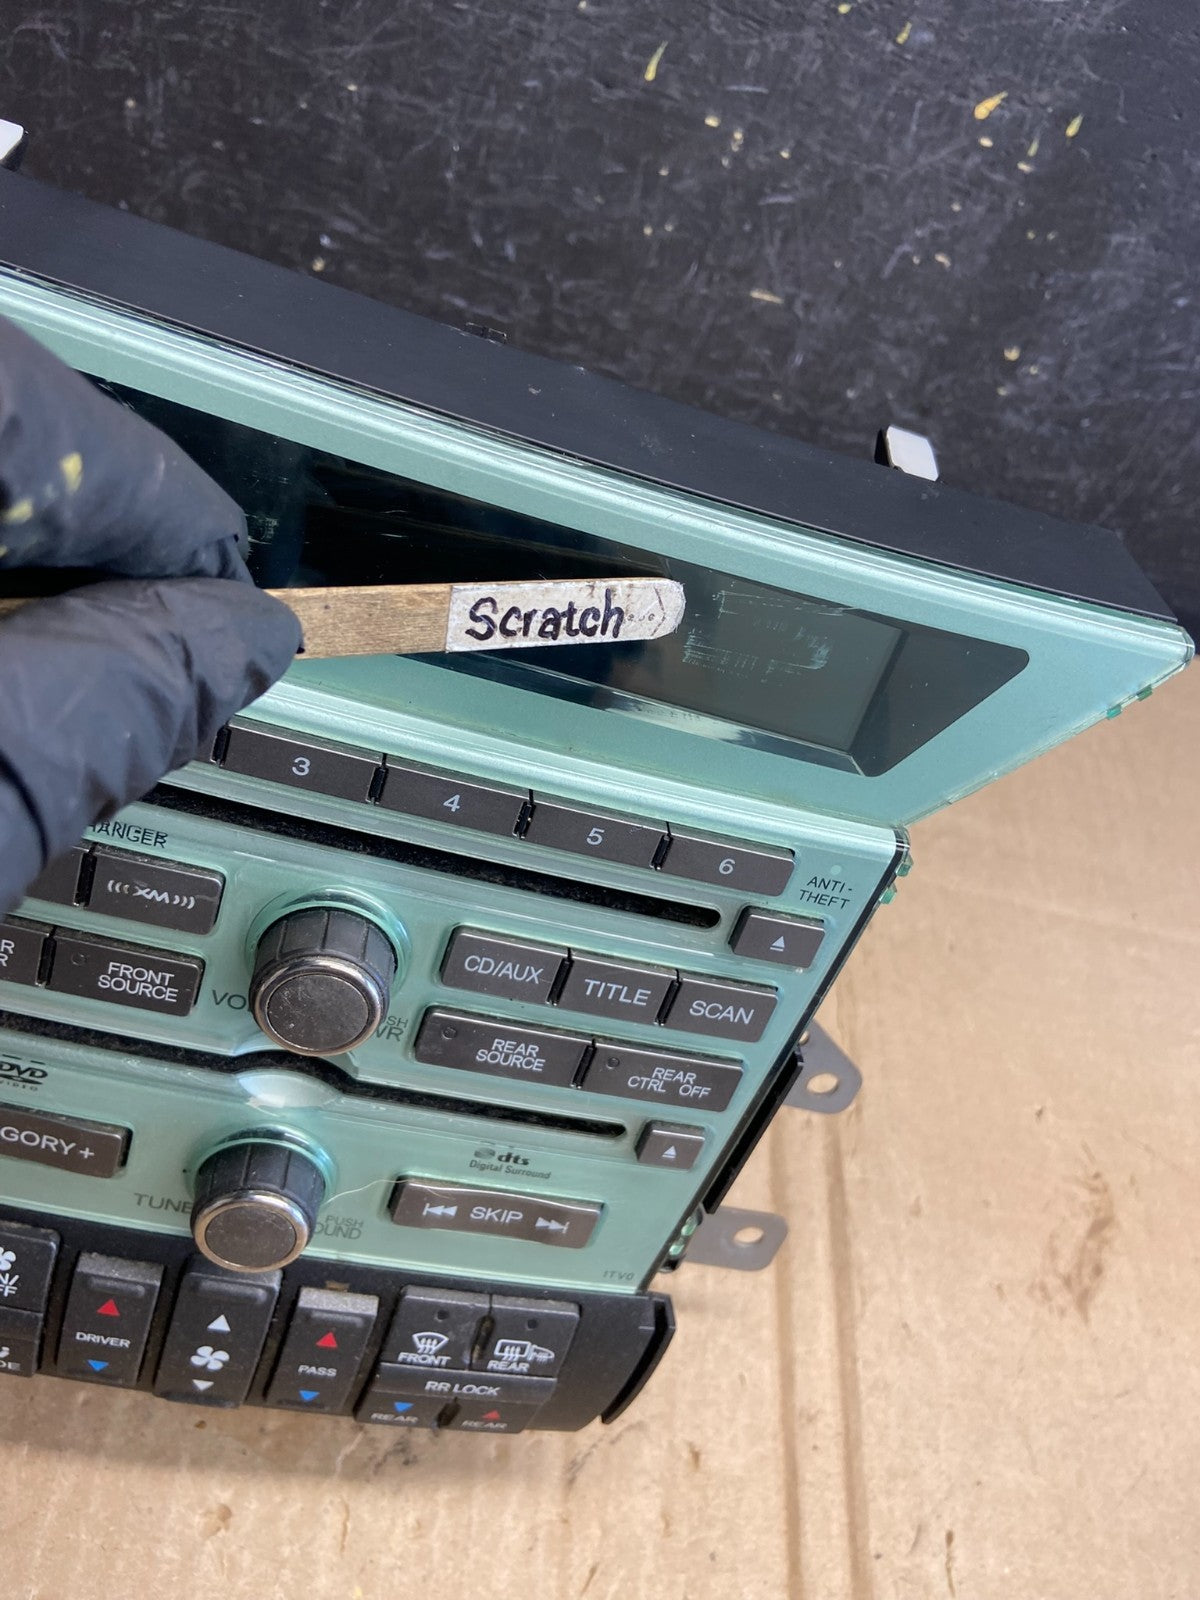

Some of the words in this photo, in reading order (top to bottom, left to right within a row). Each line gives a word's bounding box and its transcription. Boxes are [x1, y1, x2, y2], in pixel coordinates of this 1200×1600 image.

[464, 588, 625, 641] Scratch
[291, 757, 311, 776] 3
[443, 794, 461, 813] 4
[586, 827, 605, 846] 5
[718, 858, 736, 876] 6
[799, 889, 850, 911] THEFT
[107, 961, 175, 986] FRONT
[463, 954, 544, 984] CD/AUX
[97, 974, 179, 1002] SOURCE
[584, 978, 652, 1006] TITLE
[688, 1000, 755, 1025] SCAN
[491, 1038, 540, 1058] REAR
[475, 1049, 546, 1072] SOURCE
[651, 1067, 697, 1084] REAR
[627, 1076, 667, 1093] CTRL
[678, 1084, 712, 1099] OFF
[497, 1151, 530, 1166] dts
[469, 1159, 503, 1172] Digital
[504, 1165, 552, 1180] Surround
[325, 1214, 364, 1229] PUSH
[469, 1206, 524, 1225] SKIP
[75, 1331, 132, 1349] DRIVER
[397, 1351, 452, 1367] FRONT
[486, 1359, 531, 1373] REAR
[297, 1364, 337, 1378] PASS
[424, 1380, 452, 1393] RR
[452, 1382, 501, 1396] LOCK
[370, 1411, 419, 1424] REAR
[461, 1419, 509, 1430] REAR
